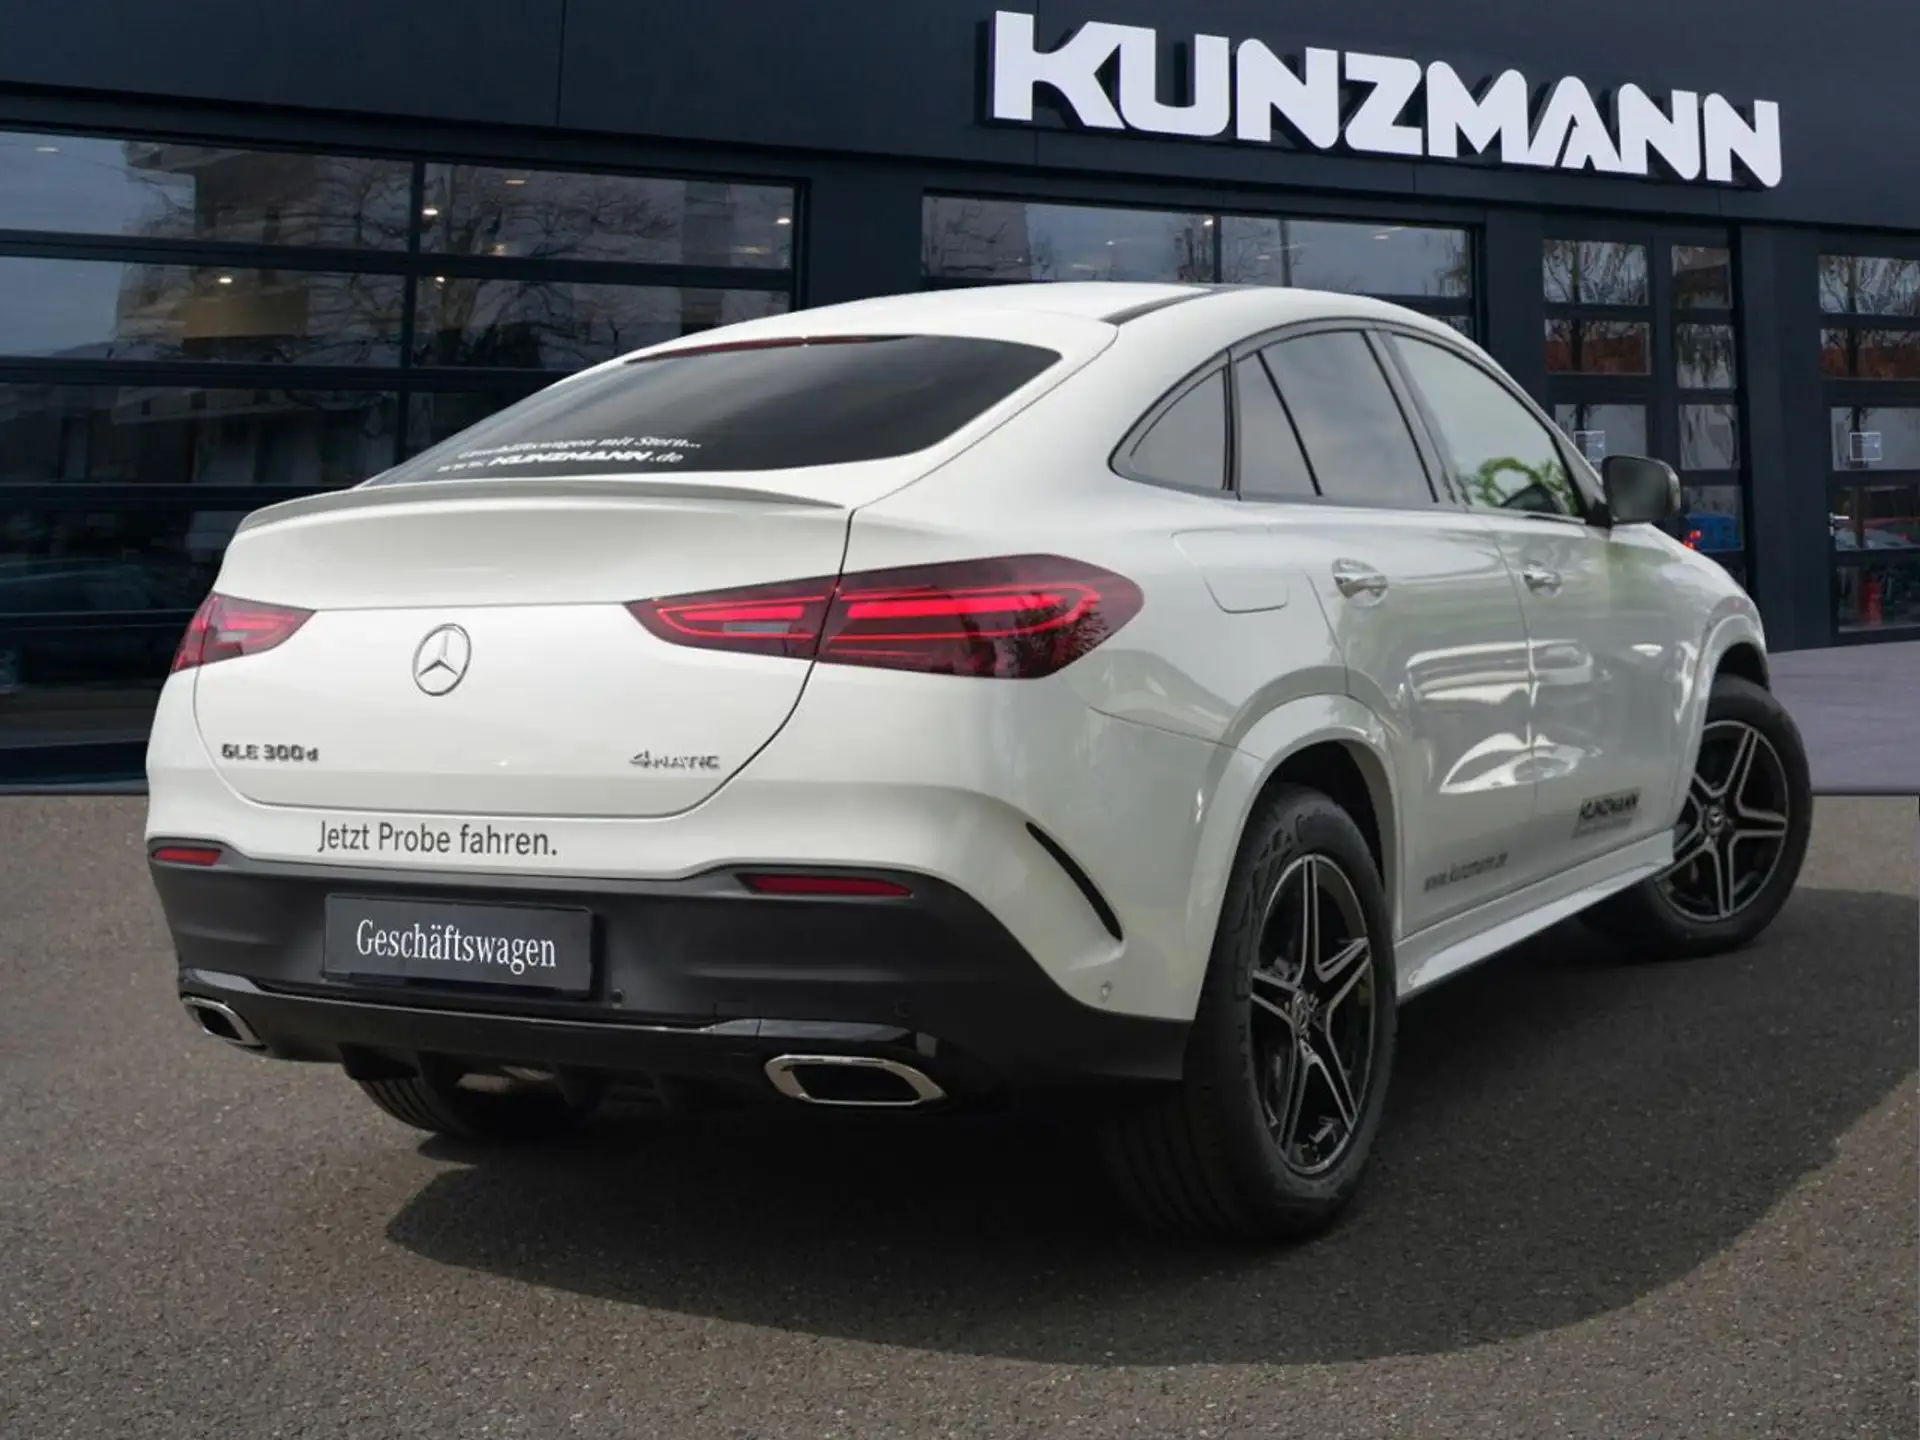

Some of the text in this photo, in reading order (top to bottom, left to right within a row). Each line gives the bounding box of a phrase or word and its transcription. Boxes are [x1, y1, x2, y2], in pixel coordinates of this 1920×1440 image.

[993, 10, 1783, 188] KUNZMANN
[221, 743, 260, 760] GLE
[318, 820, 559, 856] Jetzt Probe fahren.
[356, 918, 557, 976] Geschäftswagen
